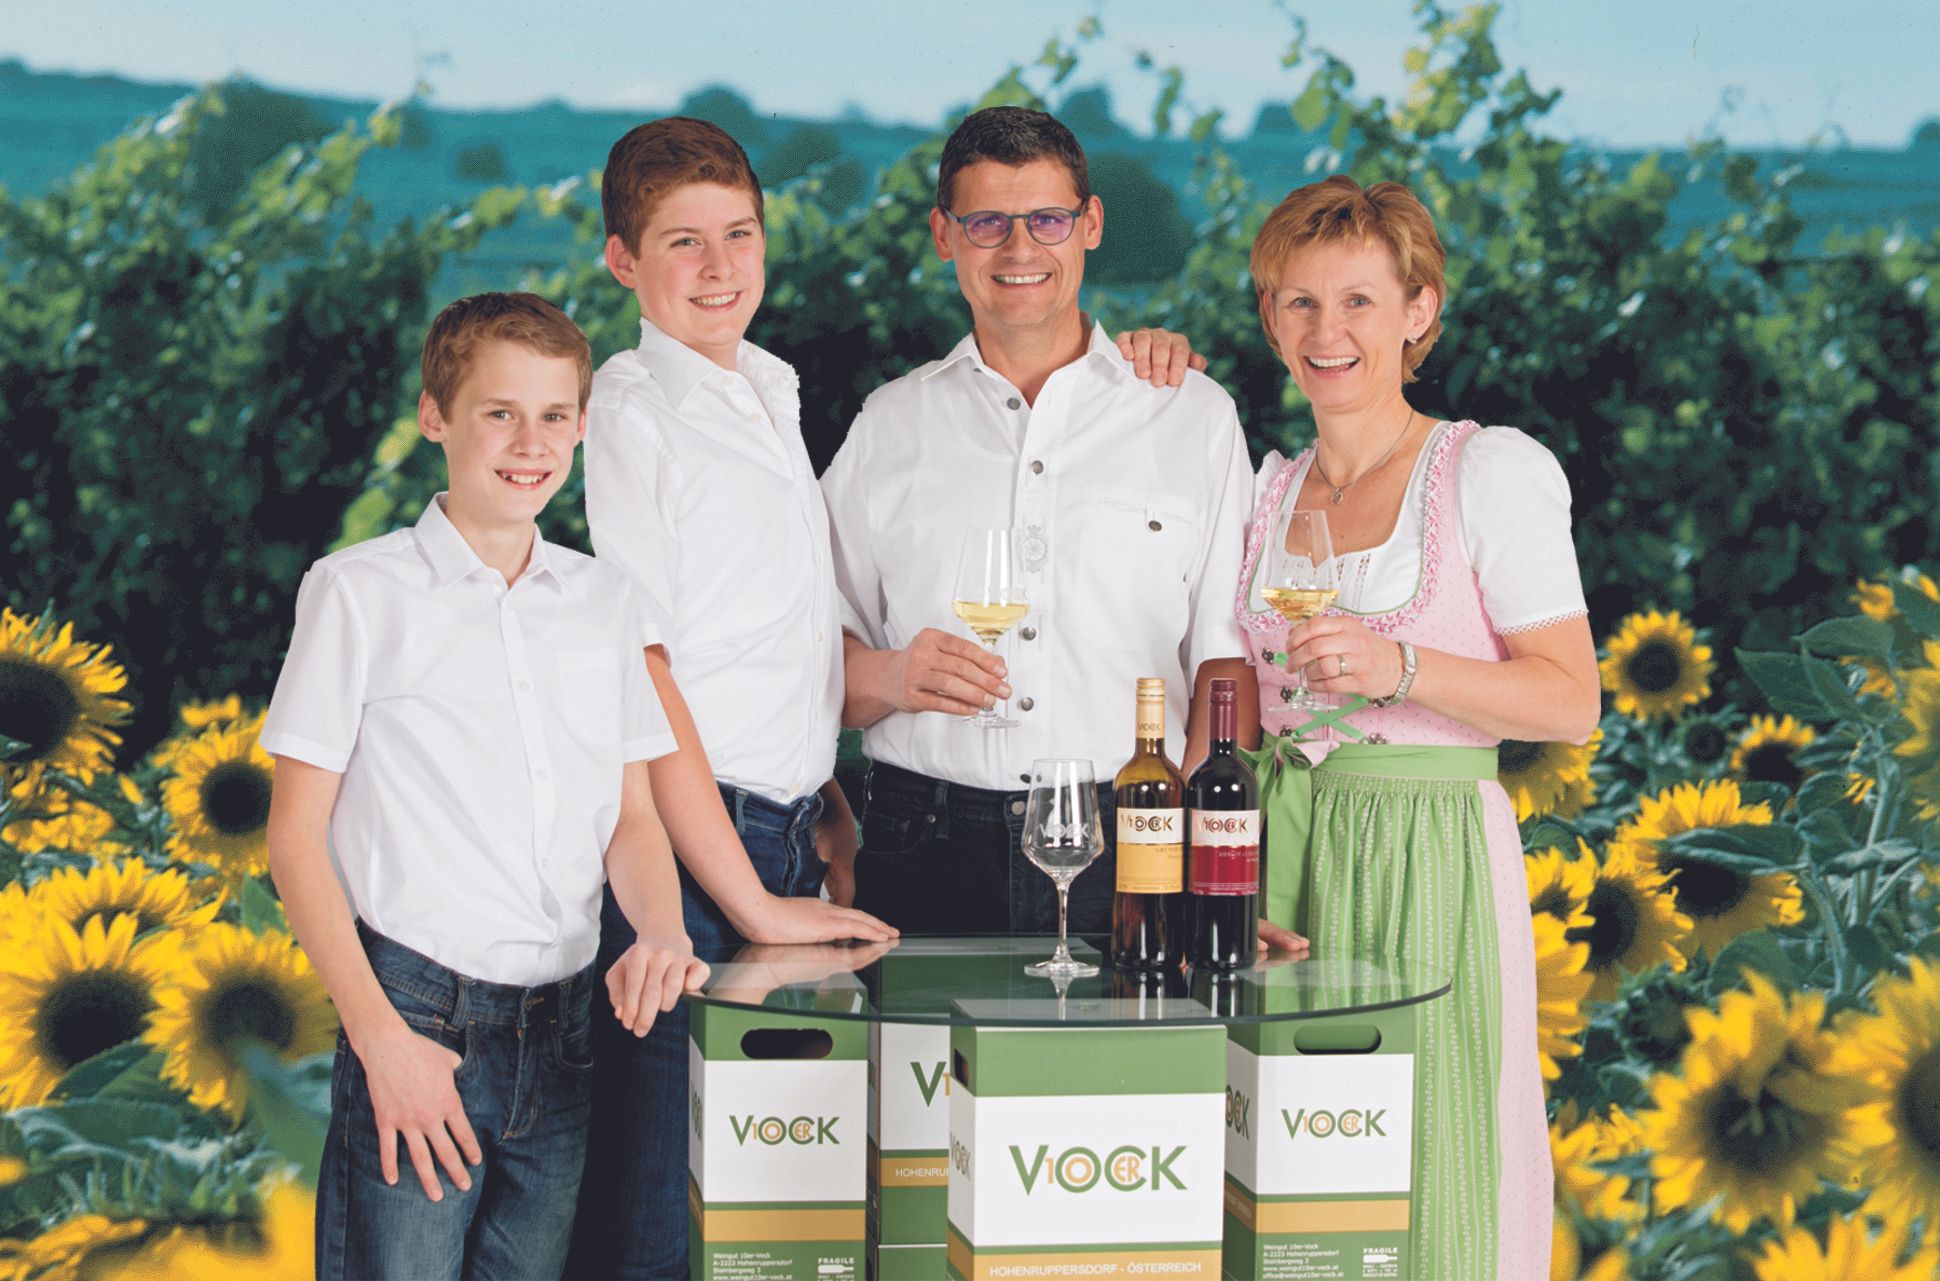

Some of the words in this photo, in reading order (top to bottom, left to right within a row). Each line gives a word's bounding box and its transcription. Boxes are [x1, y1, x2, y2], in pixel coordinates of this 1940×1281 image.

[1225, 1084, 1250, 1141] OCK
[1281, 1108, 1387, 1140] VOCK
[728, 1115, 841, 1147] VOCK
[1008, 1145, 1188, 1196] VOCK
[989, 1264, 1117, 1277] HOHENRUPPERSDORF
[1127, 1262, 1201, 1274] ÖSTERREICH
